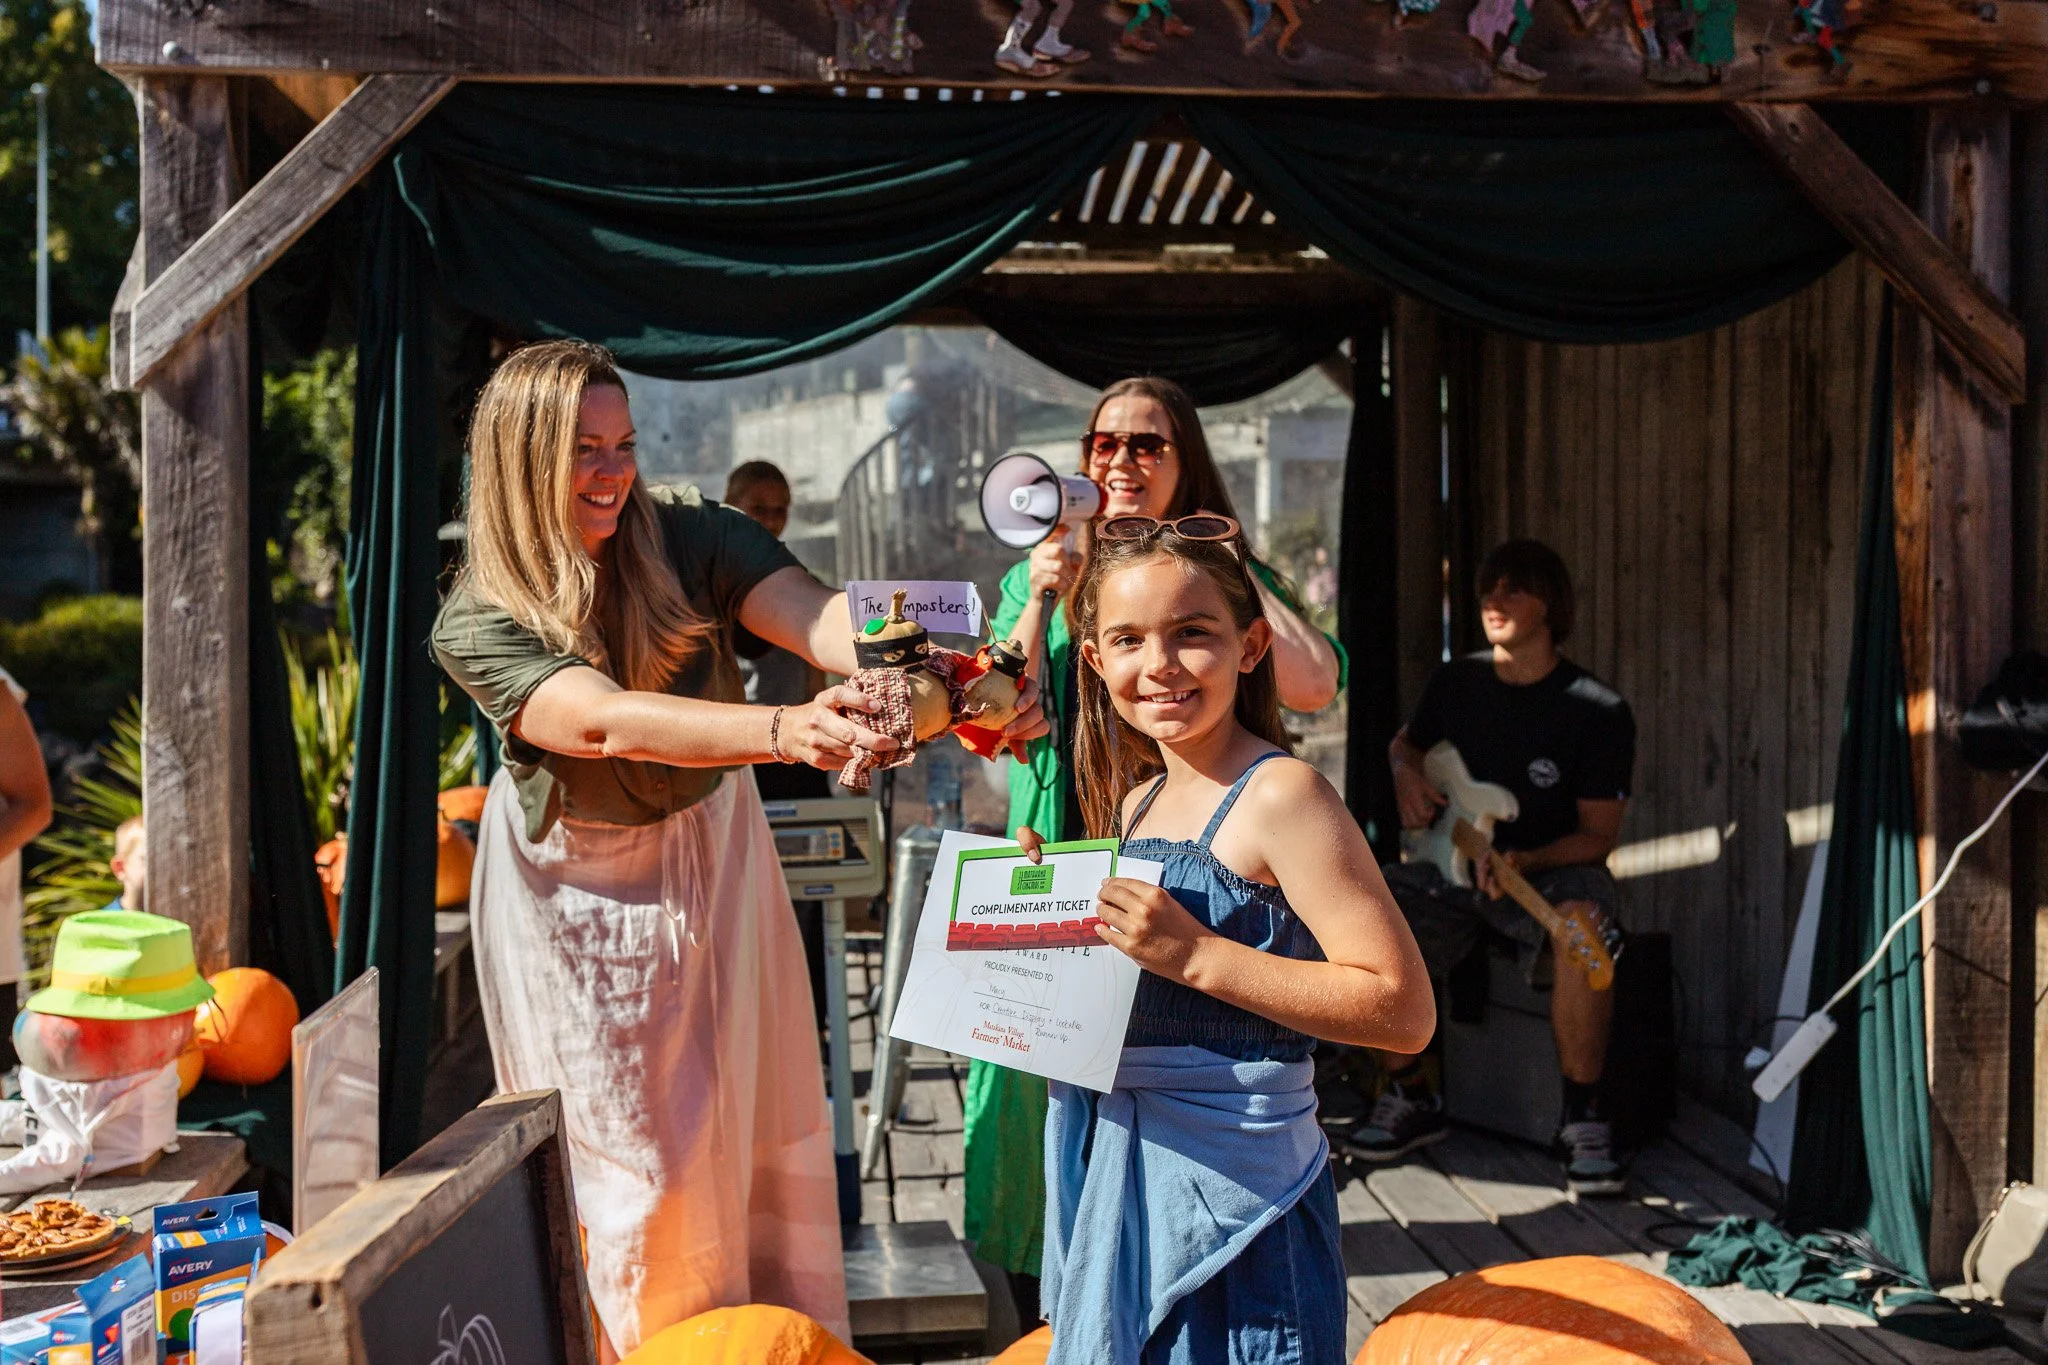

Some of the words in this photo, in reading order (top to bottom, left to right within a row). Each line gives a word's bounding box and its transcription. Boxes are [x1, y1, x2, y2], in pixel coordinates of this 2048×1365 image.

[861, 596, 884, 614] The
[901, 595, 976, 620] mposters!
[971, 901, 1054, 916] COMPLIMENTARY
[1055, 899, 1091, 912] TICKET
[1015, 948, 1048, 962] AWARD
[984, 960, 1011, 973] PROUDLY
[1011, 964, 1044, 980] PRESENTED
[1044, 973, 1054, 982] TO
[971, 1027, 1003, 1045] Farmers'
[1003, 1035, 1031, 1053] Market
[1008, 1025, 1025, 1039] Village
[162, 1215, 190, 1226] AVERY
[168, 1259, 213, 1277] AVERY
